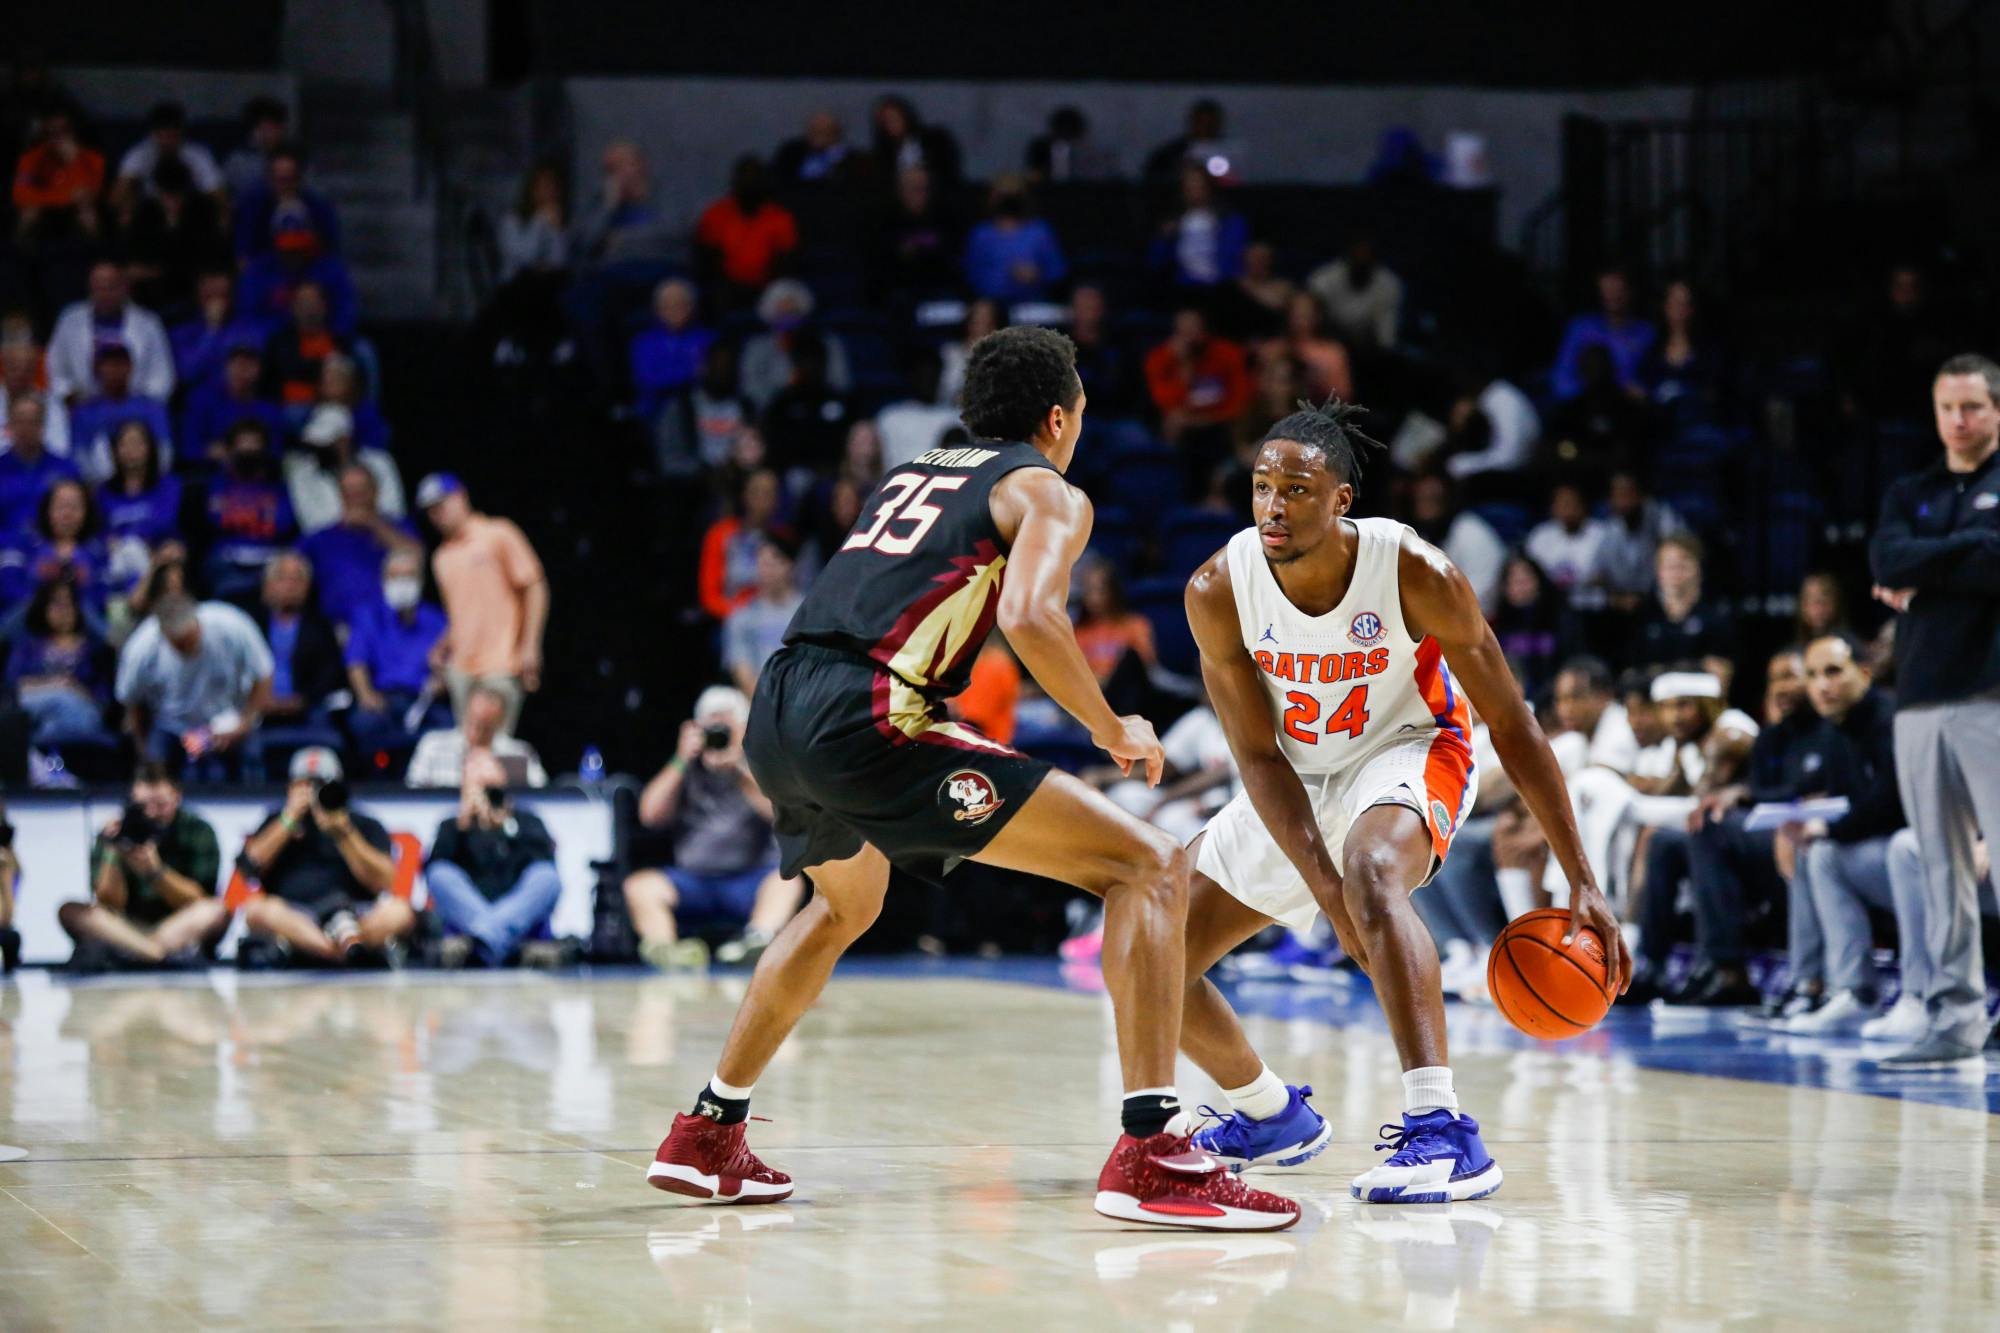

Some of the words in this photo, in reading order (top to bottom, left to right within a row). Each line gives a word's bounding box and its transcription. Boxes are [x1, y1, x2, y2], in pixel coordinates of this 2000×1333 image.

[841, 471, 973, 555] 35
[1352, 634, 1384, 646] GRADUATE
[1353, 613, 1379, 638] SEC
[1254, 647, 1389, 684] GATORS
[1283, 684, 1370, 745] 24
